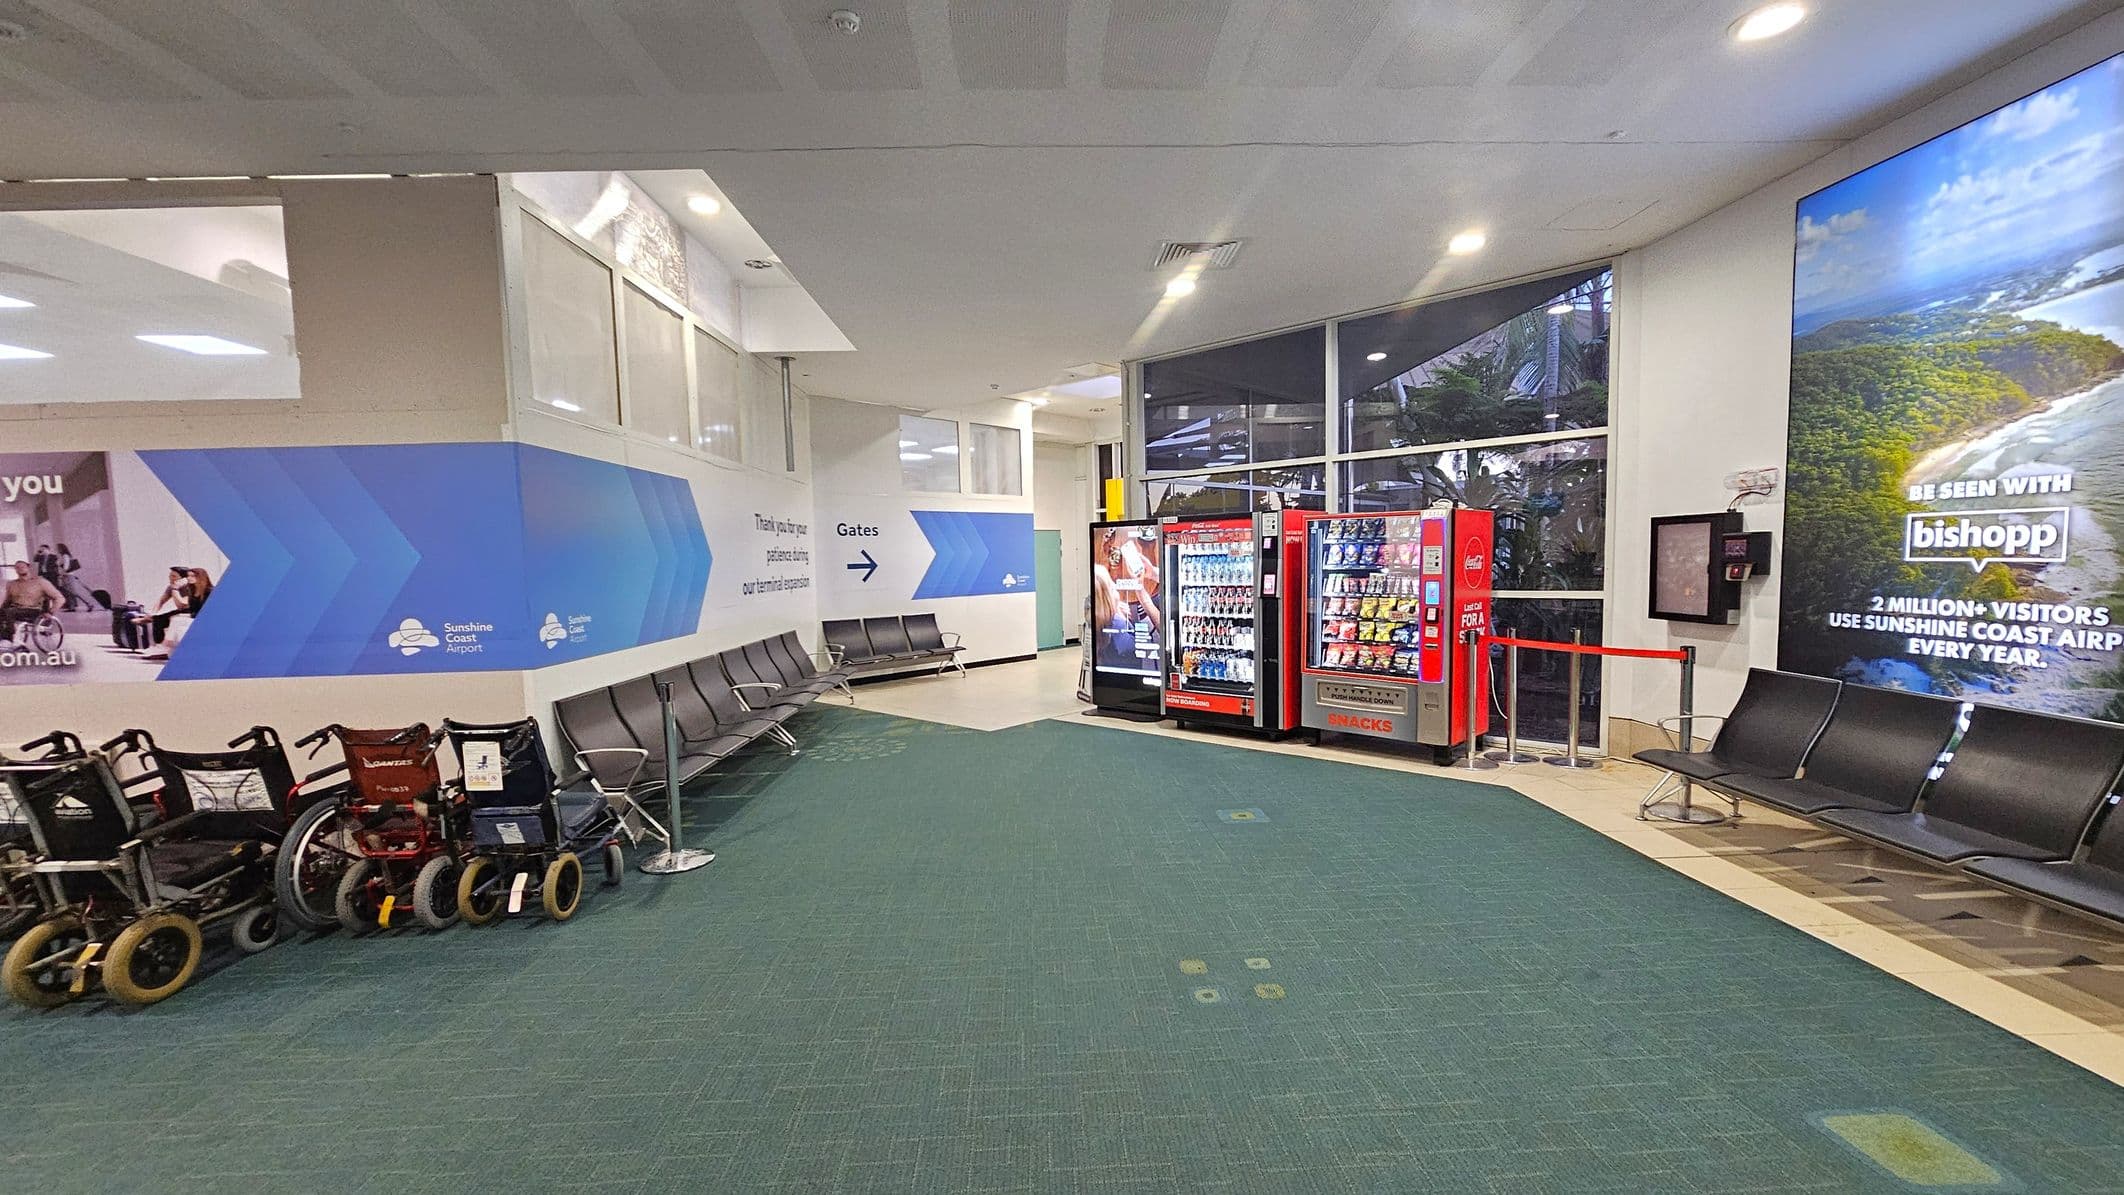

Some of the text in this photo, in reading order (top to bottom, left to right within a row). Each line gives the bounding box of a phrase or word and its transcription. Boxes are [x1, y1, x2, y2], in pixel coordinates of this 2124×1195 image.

[1, 474, 64, 502] you
[1908, 473, 2072, 501] BE SEEN WITH
[754, 513, 776, 532] Thank
[776, 521, 787, 536] you
[836, 523, 879, 537] Gates
[1913, 518, 2058, 555] bishopp
[767, 546, 809, 566] patience during
[743, 574, 809, 595] our terminal expansion
[1461, 612, 1485, 628] FOR A
[1871, 596, 2110, 626] 2 MILLION+ VISITORS
[444, 622, 493, 633] Sunshine
[445, 633, 477, 643] Coast
[1829, 612, 2124, 651] USE SUNSHINE COAST AIRP
[446, 643, 483, 655] Airport
[1908, 638, 2048, 668] EVERY YEAR.
[1331, 693, 1394, 705] PUSH HANDLE DOWN
[1328, 712, 1393, 733] SNACKS
